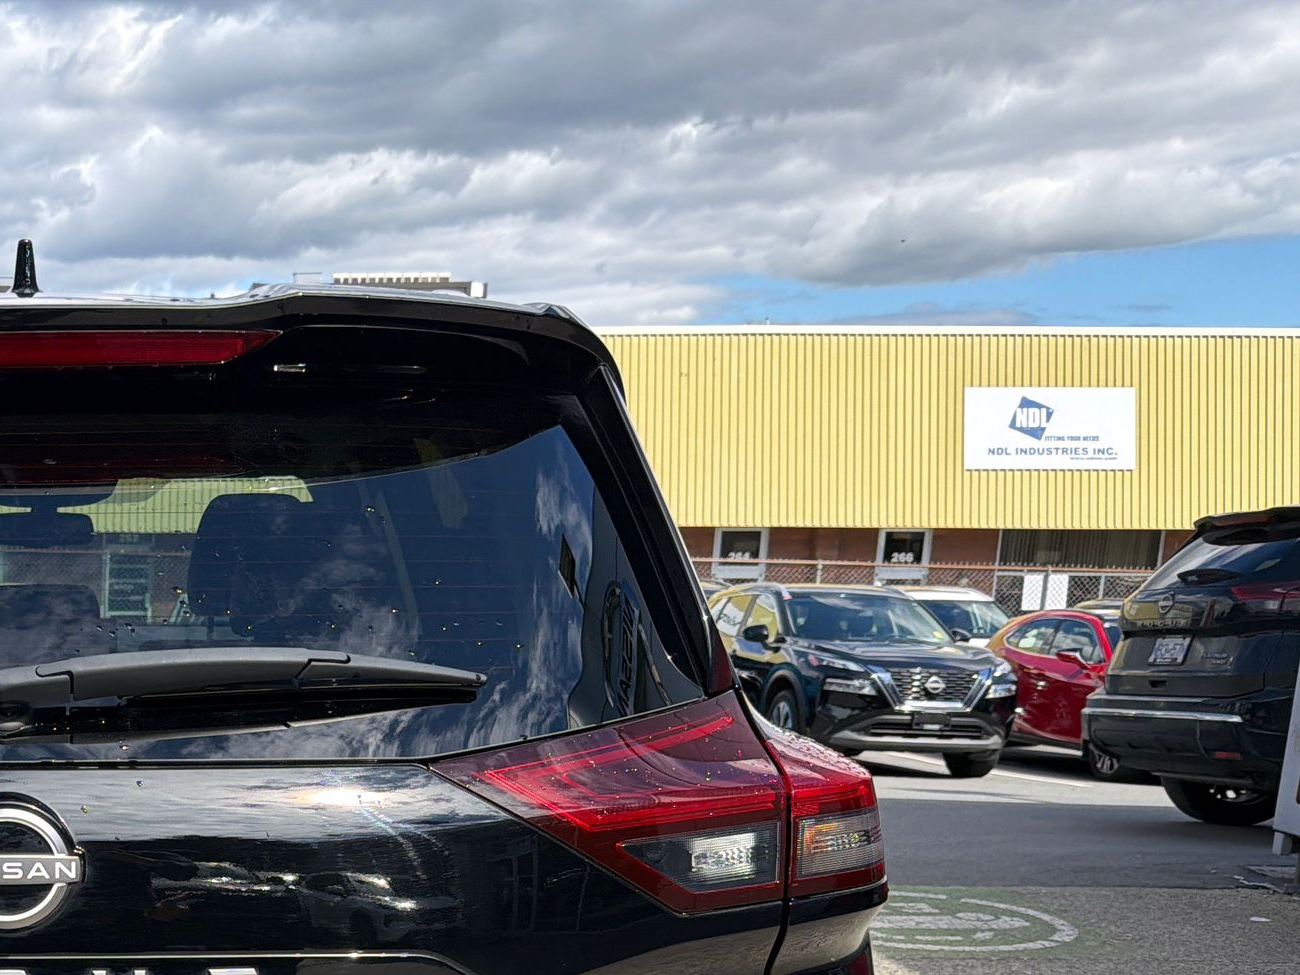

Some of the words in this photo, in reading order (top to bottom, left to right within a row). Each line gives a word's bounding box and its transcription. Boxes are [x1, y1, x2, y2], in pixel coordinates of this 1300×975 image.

[1015, 407, 1050, 428] NDL
[987, 447, 1011, 456] NDL
[1015, 447, 1089, 456] INDUSTRIES
[1093, 447, 1118, 456] INC.
[890, 551, 915, 563] 266
